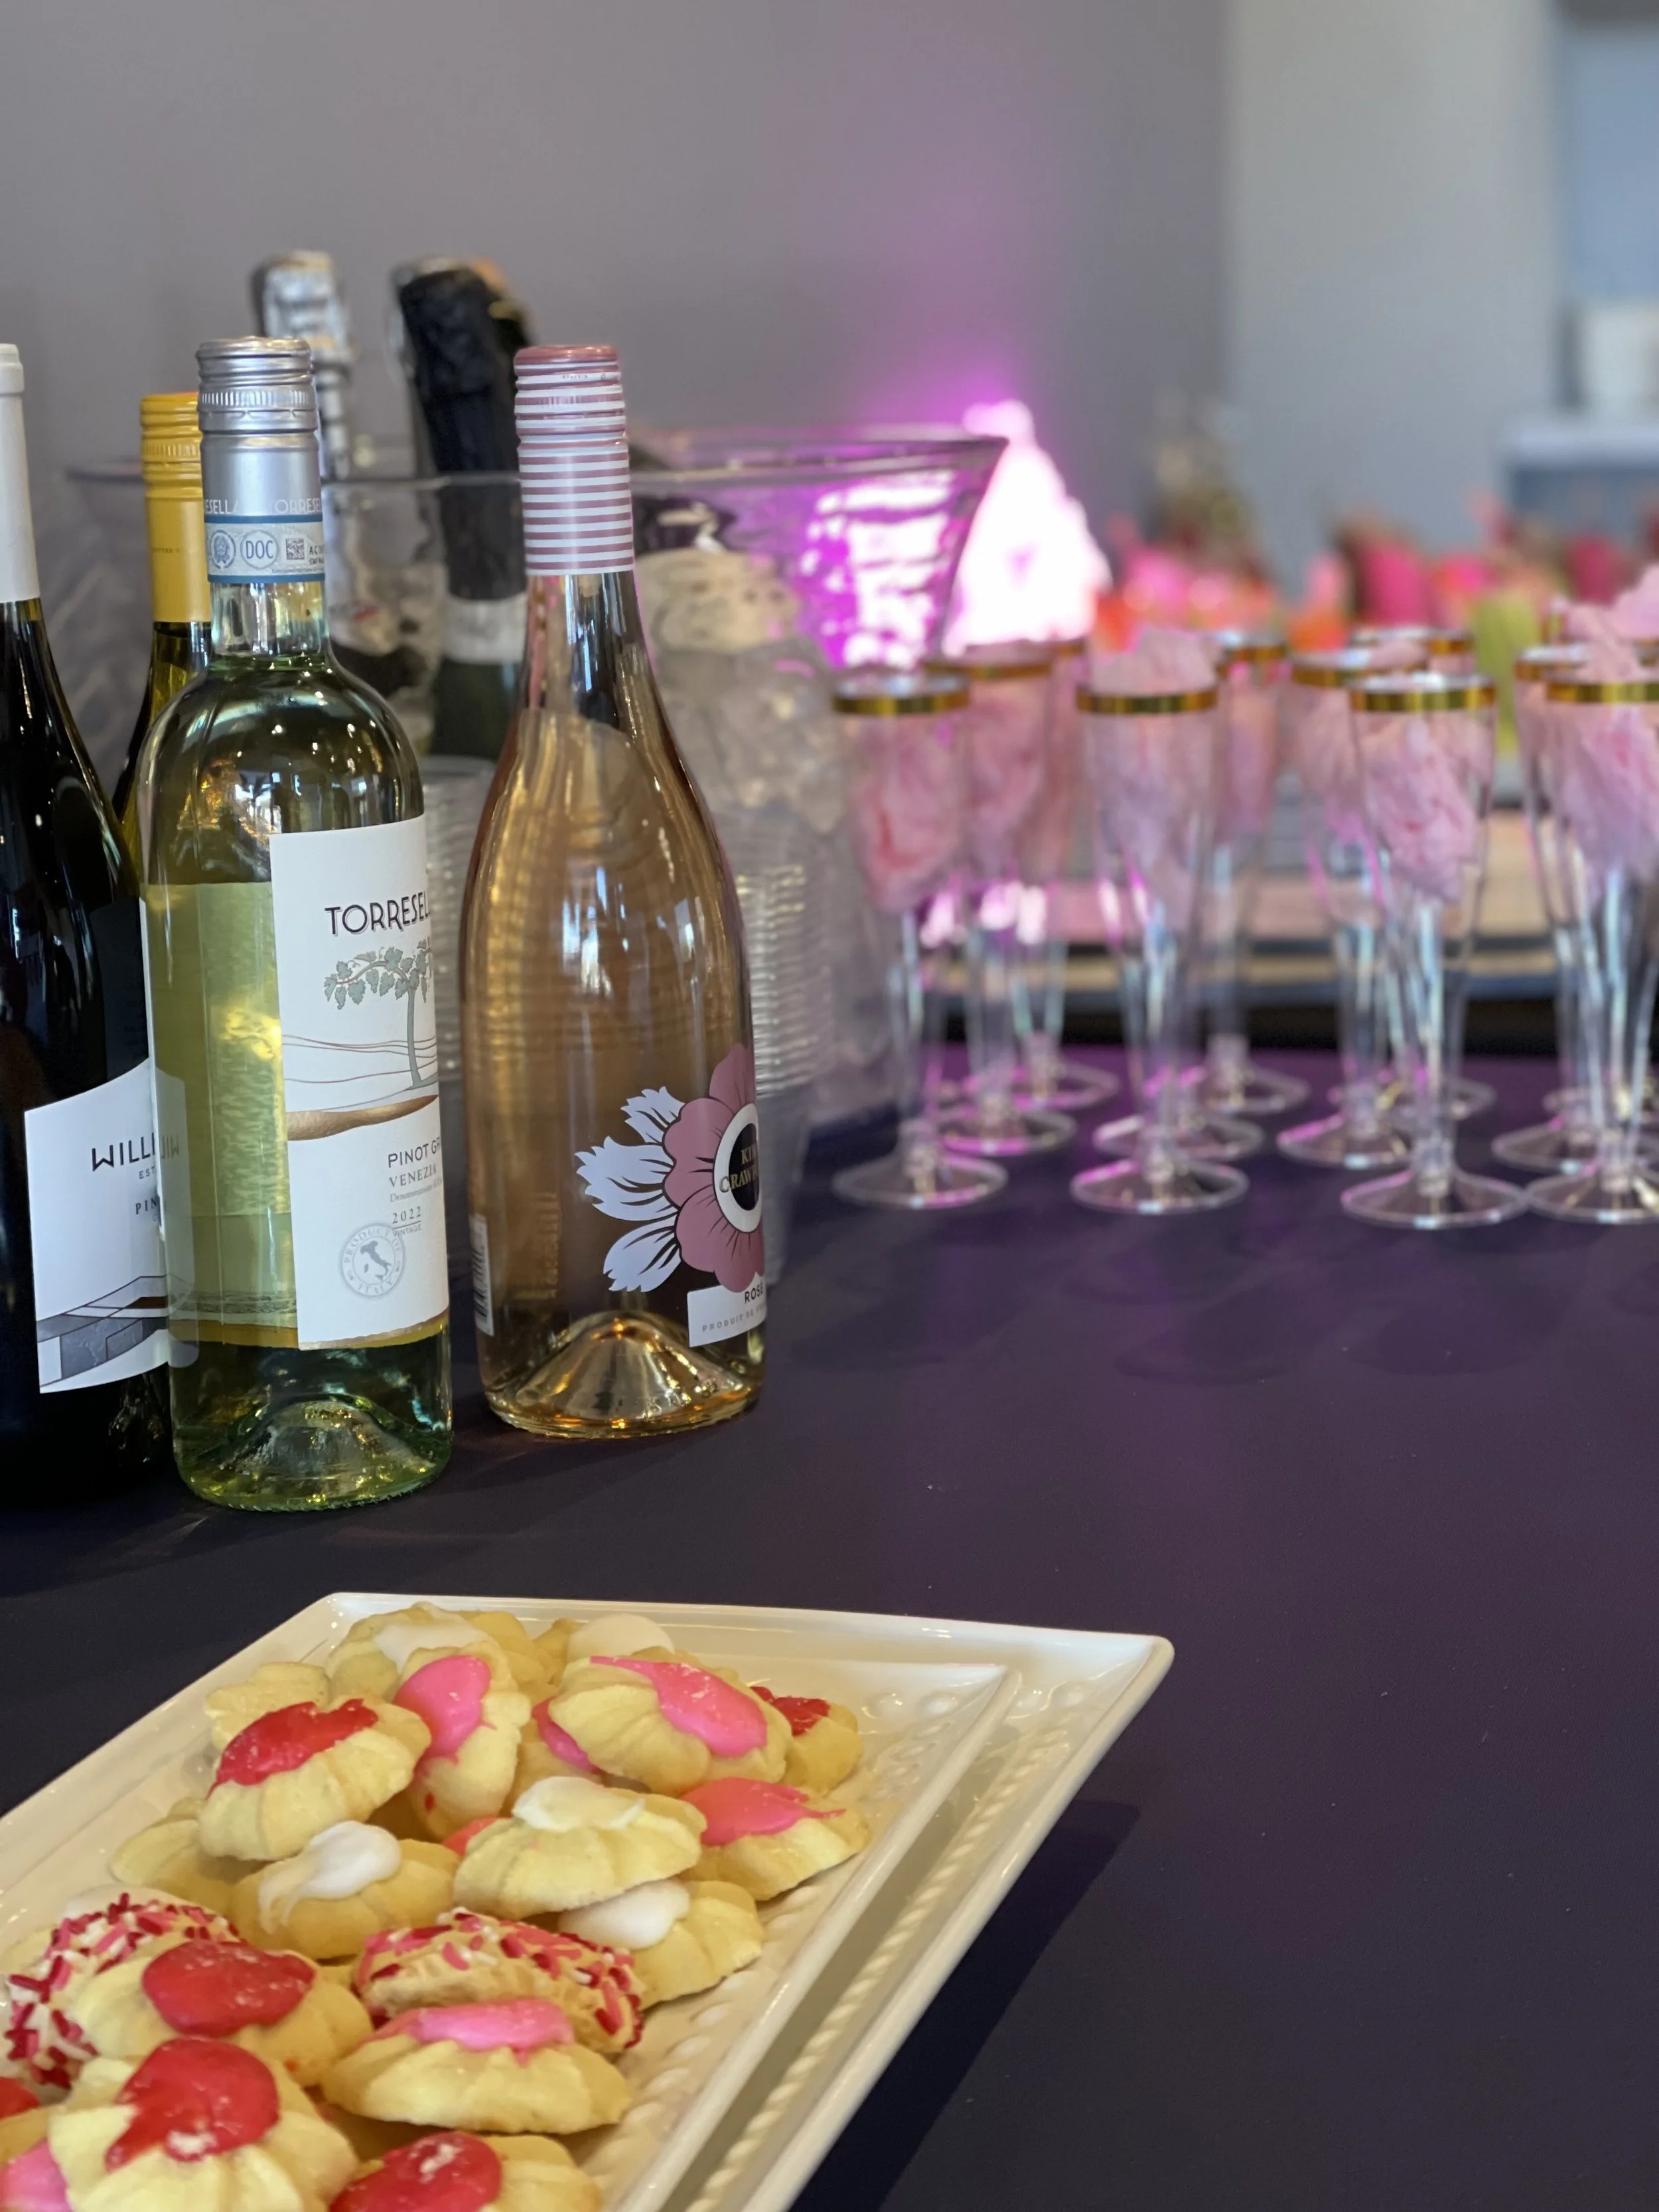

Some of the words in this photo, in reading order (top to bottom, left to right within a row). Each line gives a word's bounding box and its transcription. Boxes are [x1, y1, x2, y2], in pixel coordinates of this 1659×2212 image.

[246, 540, 273, 559] DOC
[388, 1143, 429, 1168] PINOT
[389, 1163, 437, 1188] VENEZIA
[392, 1206, 421, 1224] 2022
[392, 1224, 422, 1237] VINTAGE
[358, 1278, 392, 1294] ITALY
[702, 1314, 743, 1332] PRODUIT
